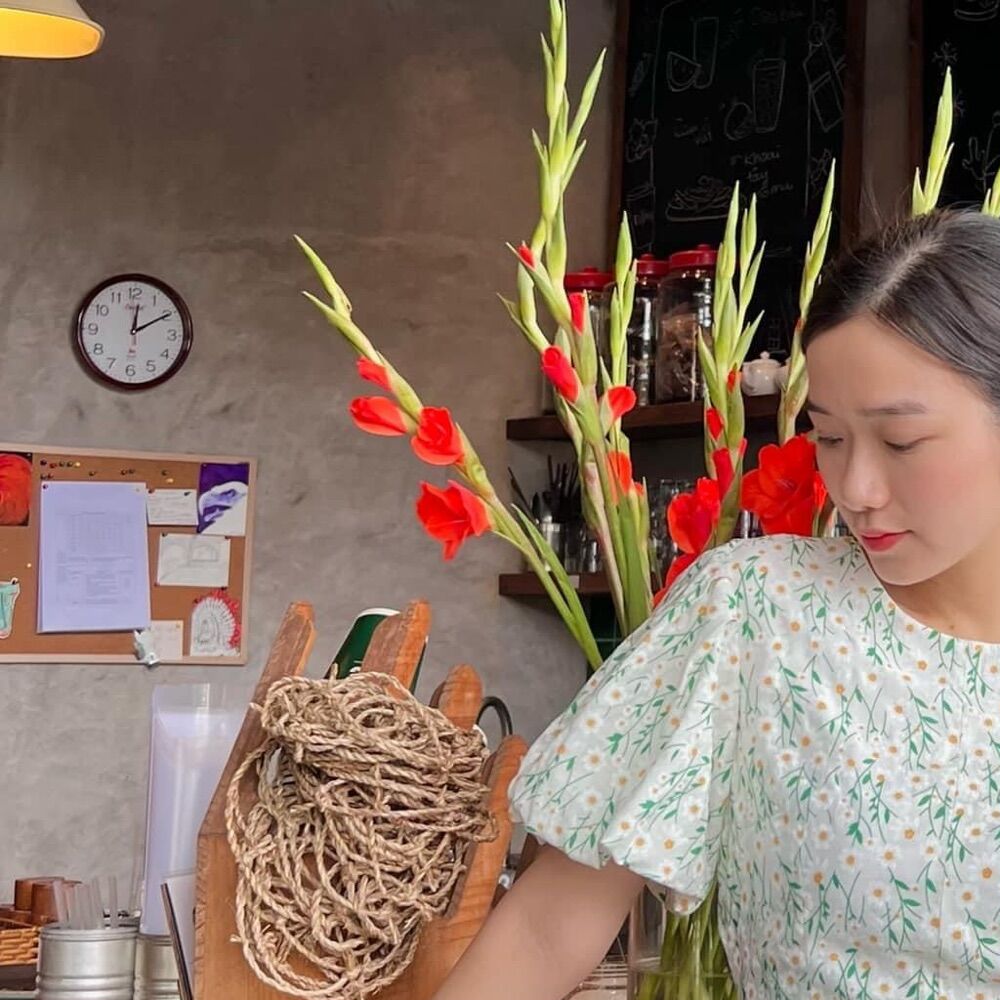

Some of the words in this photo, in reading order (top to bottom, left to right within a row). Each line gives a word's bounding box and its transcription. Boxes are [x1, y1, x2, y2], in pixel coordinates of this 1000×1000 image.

[111, 292, 121, 304] 11
[128, 287, 143, 300] 12
[96, 304, 110, 317] 10
[88, 323, 99, 336] 9
[167, 329, 178, 342] 3
[93, 343, 104, 356] 8
[160, 348, 169, 360] 4
[107, 357, 117, 369] 7
[146, 360, 157, 372] 5
[125, 364, 136, 377] 6
